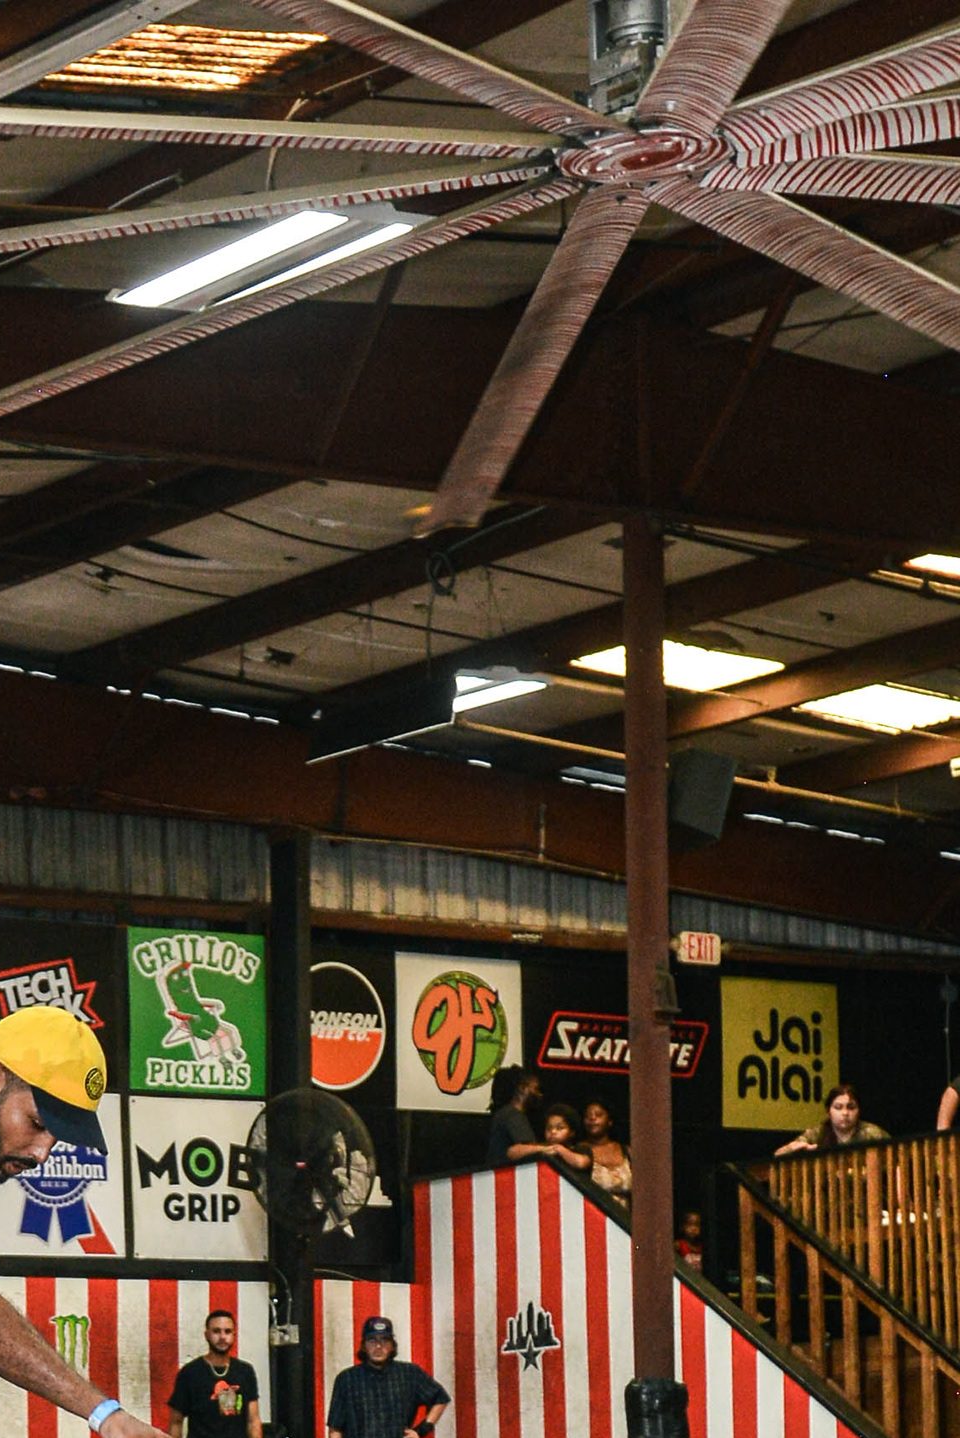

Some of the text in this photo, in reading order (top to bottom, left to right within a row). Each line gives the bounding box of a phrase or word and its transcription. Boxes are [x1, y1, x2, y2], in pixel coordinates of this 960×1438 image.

[135, 936, 258, 981] GRILLO'S
[687, 933, 716, 962] EXIT
[310, 1010, 378, 1029] ONSON
[753, 1007, 822, 1056] Jai
[149, 1061, 249, 1087] PICKLES
[737, 1054, 823, 1103] Alai
[43, 1155, 105, 1179] Ribbon
[136, 1136, 261, 1192] MOB
[163, 1192, 240, 1222] GRIP
